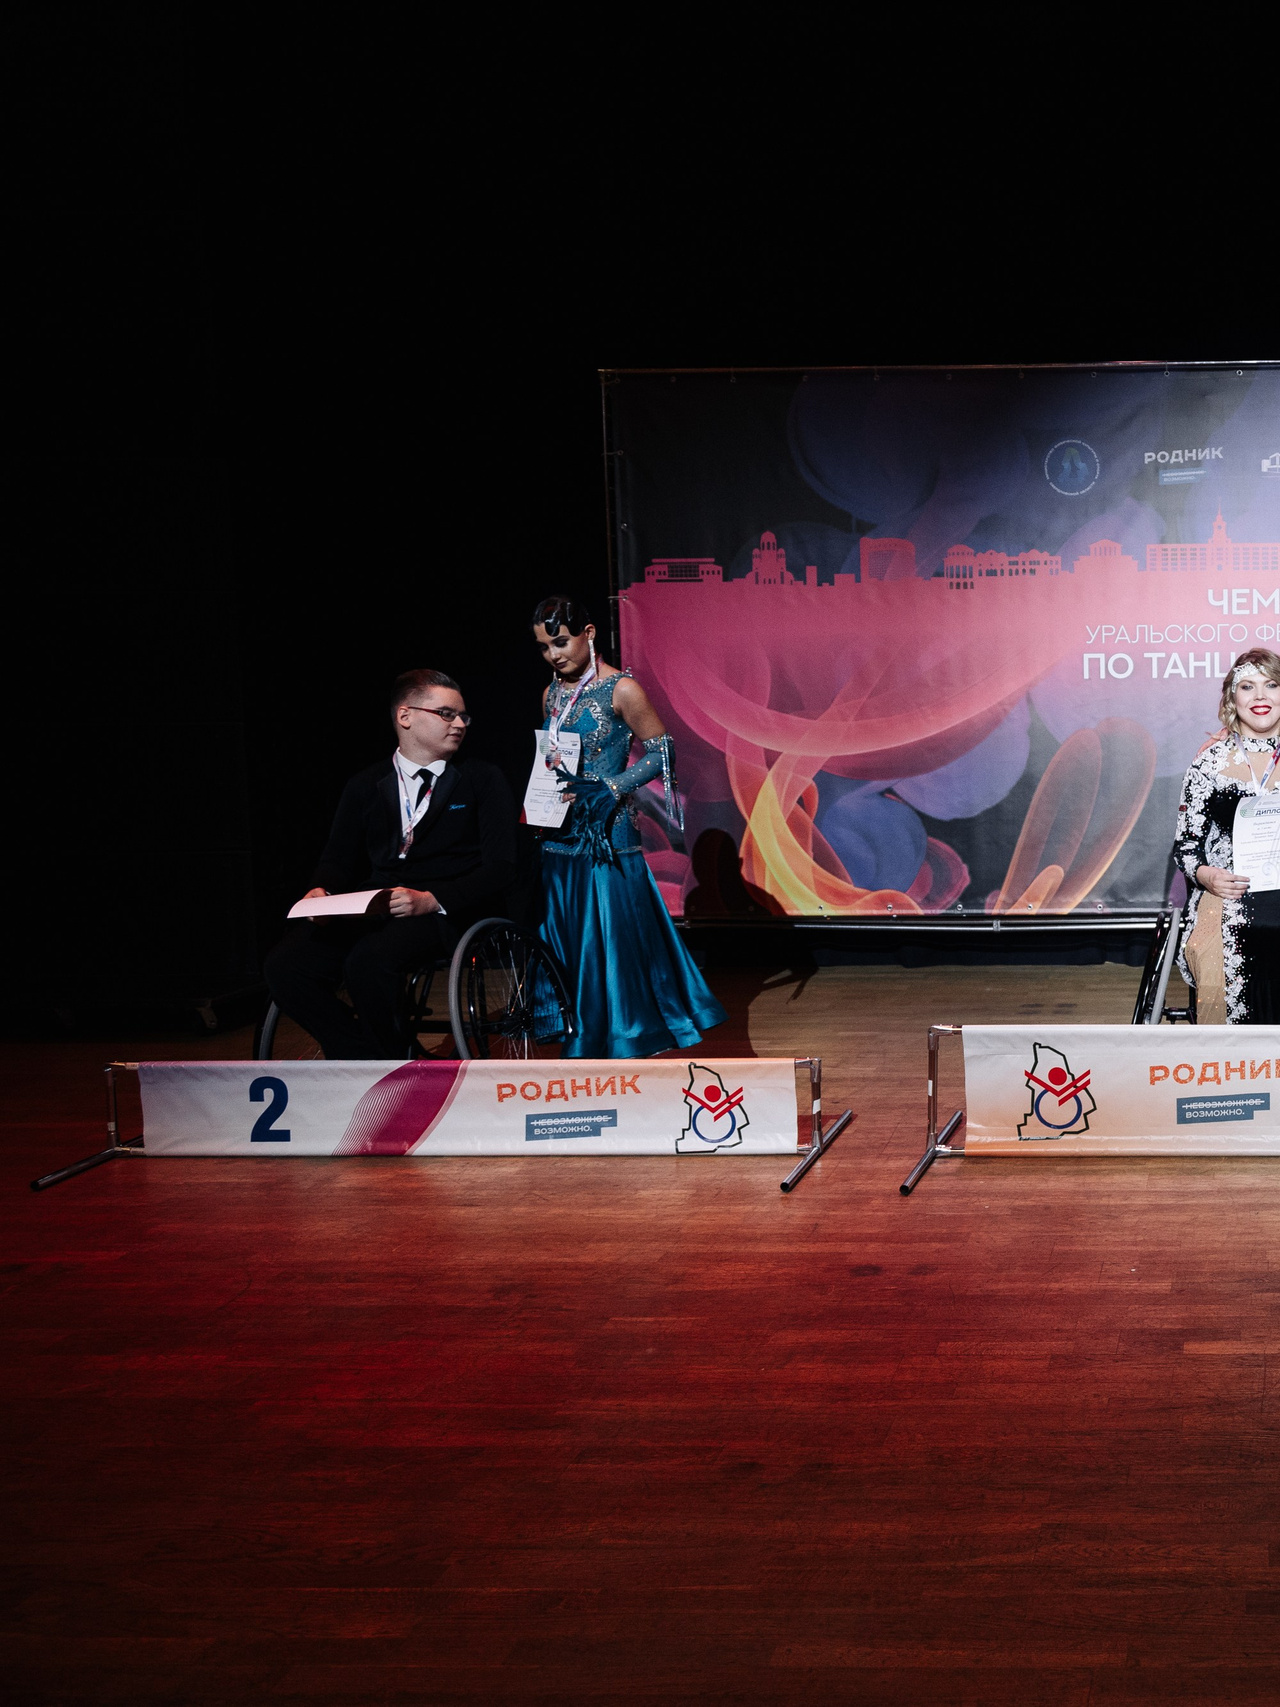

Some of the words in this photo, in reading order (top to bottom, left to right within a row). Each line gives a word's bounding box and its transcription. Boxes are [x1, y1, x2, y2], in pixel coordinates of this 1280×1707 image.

[1144, 446, 1224, 465] РОДНИК
[1085, 623, 1248, 644] УРАЛЬСКОГО
[1083, 652, 1134, 679] ПО
[496, 1074, 642, 1102] РОДНИК
[249, 1076, 291, 1142] 2
[1185, 1108, 1245, 1119] ВОЗМОЖНО.
[534, 1125, 593, 1135] ВОЗМОЖНО.
